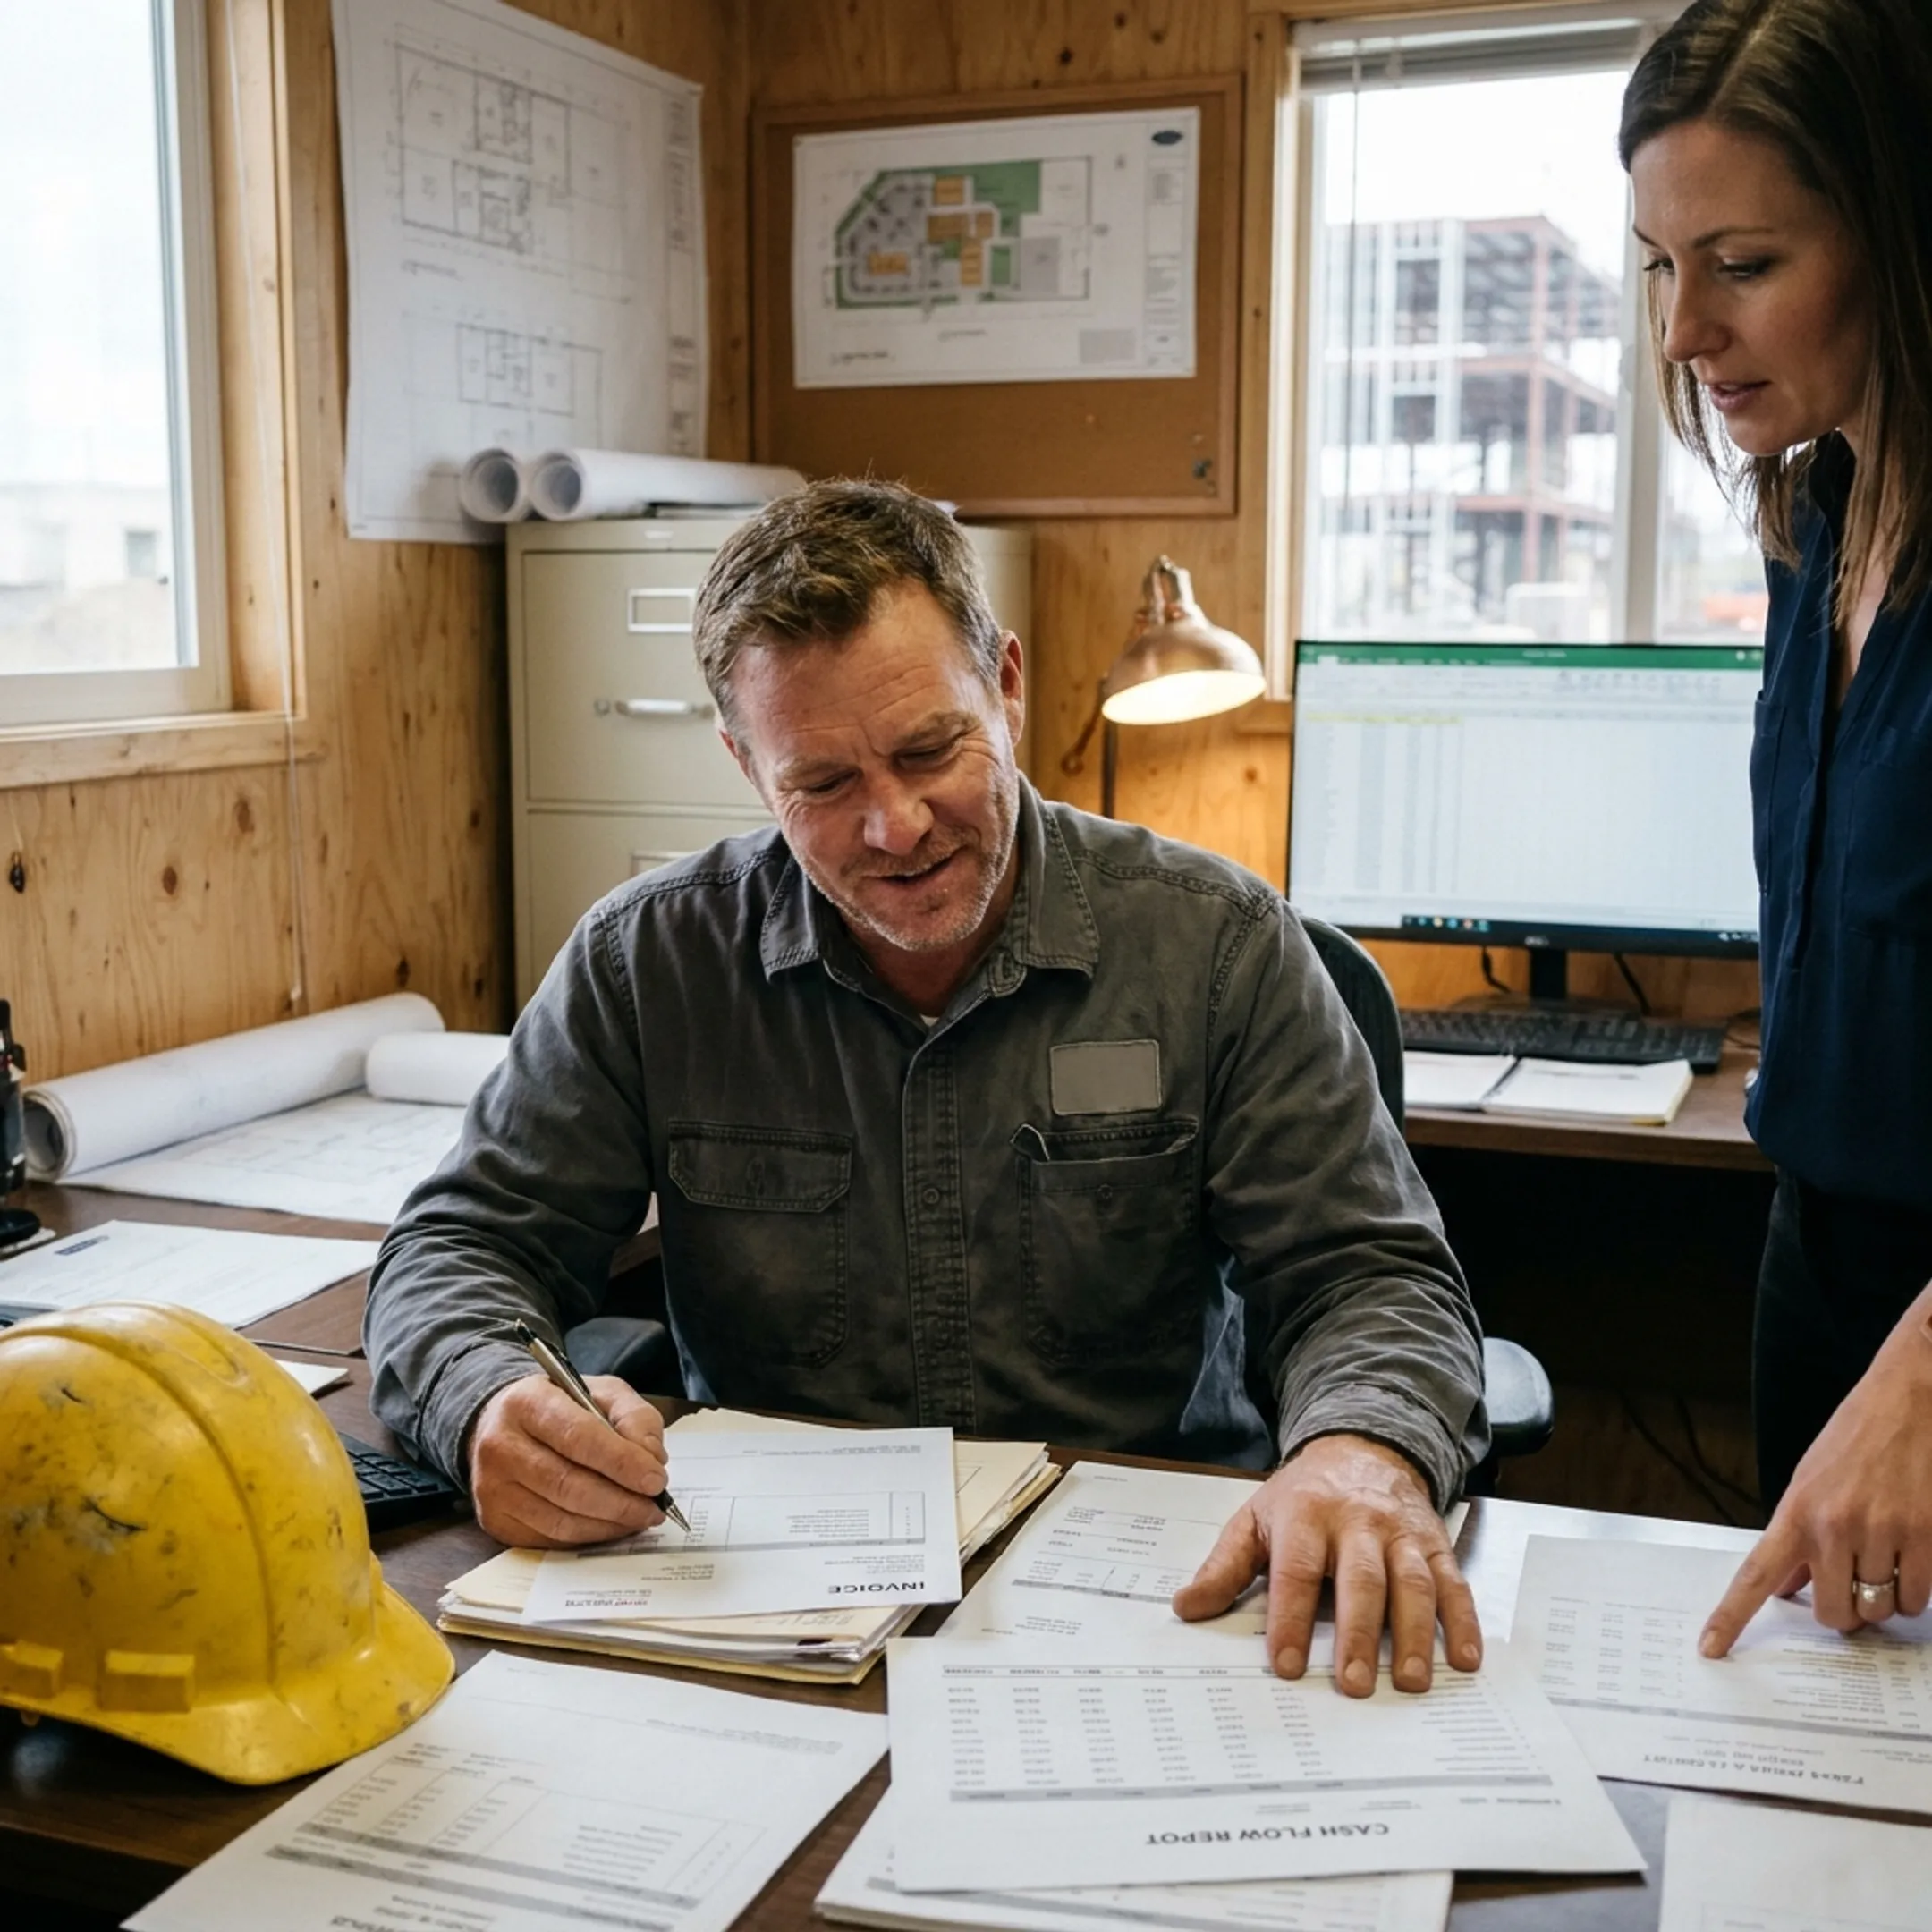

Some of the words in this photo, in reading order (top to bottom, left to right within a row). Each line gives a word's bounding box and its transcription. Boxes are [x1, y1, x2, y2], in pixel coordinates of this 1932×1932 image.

[828, 1581, 925, 1594] INVOICE
[1239, 1826, 1311, 1841] FLOW
[1320, 1823, 1389, 1837] CASH
[1147, 1830, 1231, 1845] REPOT
